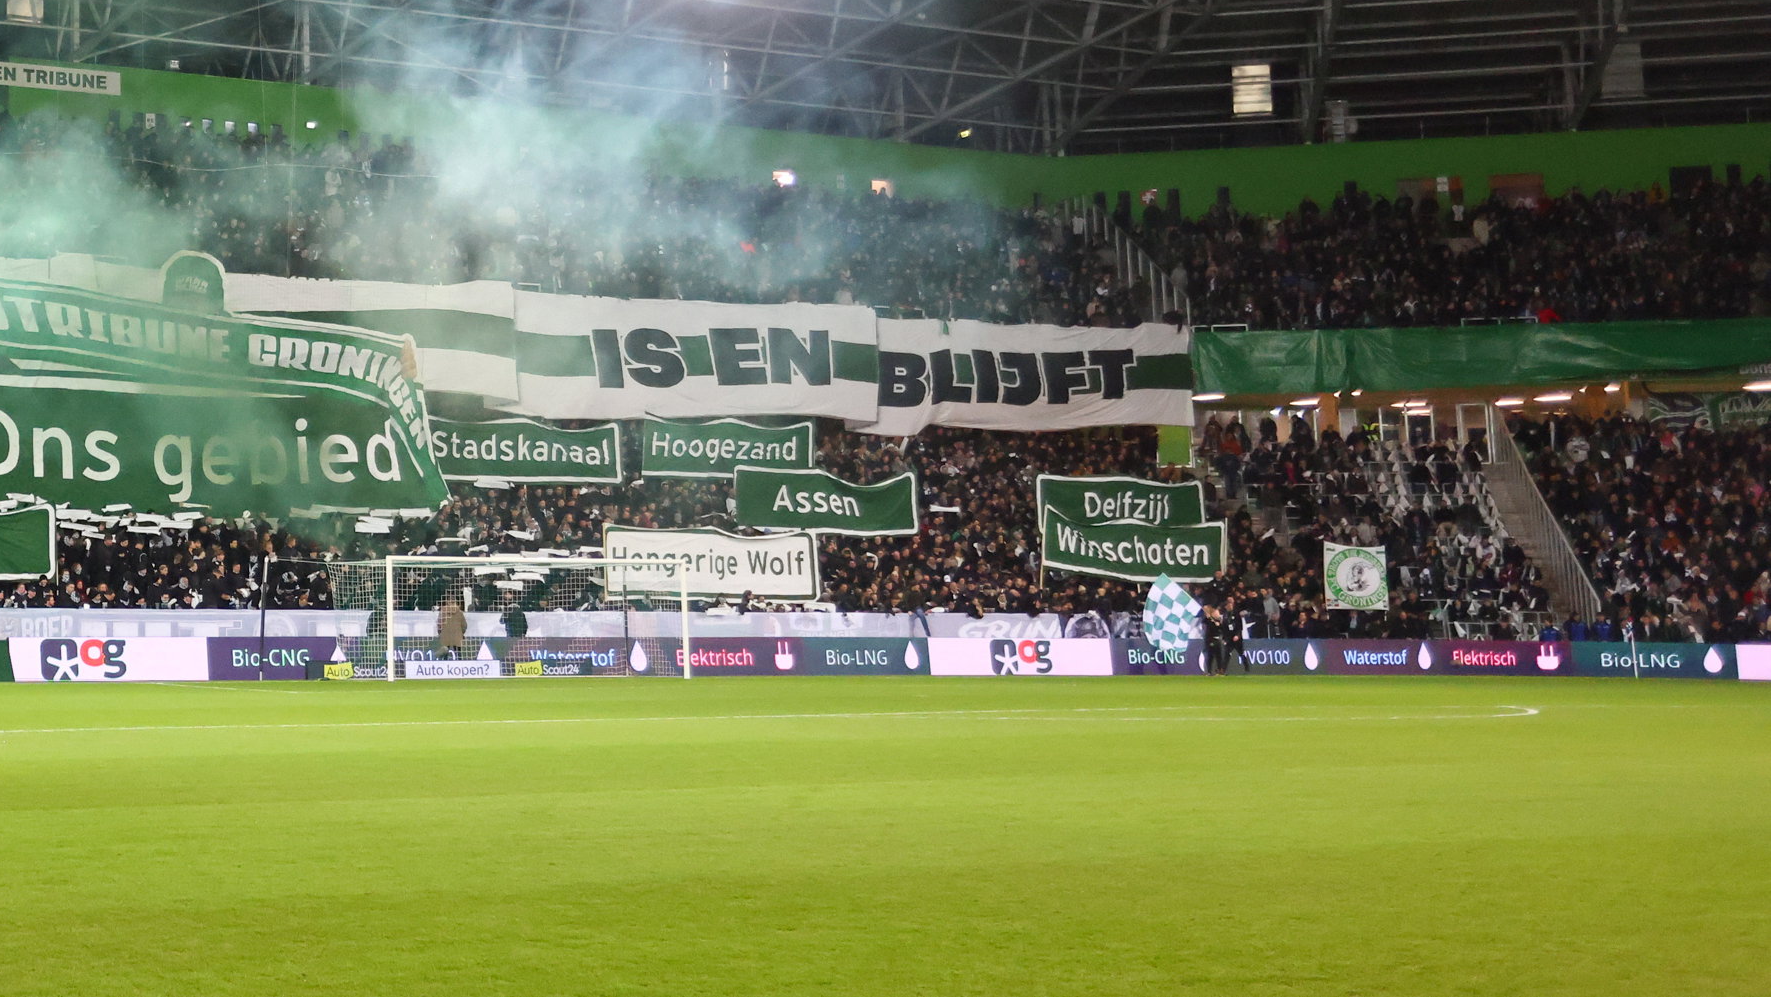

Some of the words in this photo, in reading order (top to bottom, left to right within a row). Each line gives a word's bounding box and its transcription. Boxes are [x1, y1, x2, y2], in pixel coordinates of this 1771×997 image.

[22, 67, 108, 91] TRIBUNE
[592, 327, 686, 389] IS
[708, 328, 831, 387] EN
[878, 348, 1134, 407] BLIJFT
[248, 333, 427, 450] GRONINGEN
[153, 417, 402, 503] gebied
[432, 431, 611, 466] Stadskanaal
[652, 432, 797, 465] Hoogezand
[773, 484, 860, 518] Assen
[1084, 491, 1169, 527] Delfzijl
[1056, 523, 1209, 567] Winschoten
[612, 546, 738, 580] Hongerige
[747, 549, 805, 576] Wolf
[232, 649, 310, 667] Bio-CNG
[676, 649, 753, 666] Eektrisch
[826, 649, 888, 666] Bio-LNG
[1128, 650, 1185, 665] Bio-CNG
[1344, 649, 1407, 665] Waterstof
[1452, 650, 1516, 666] Elektrisch
[1600, 653, 1681, 668] Bio-LNG
[326, 662, 390, 678] AutoScout2
[416, 663, 450, 676] Auto
[453, 663, 490, 678] kopen?
